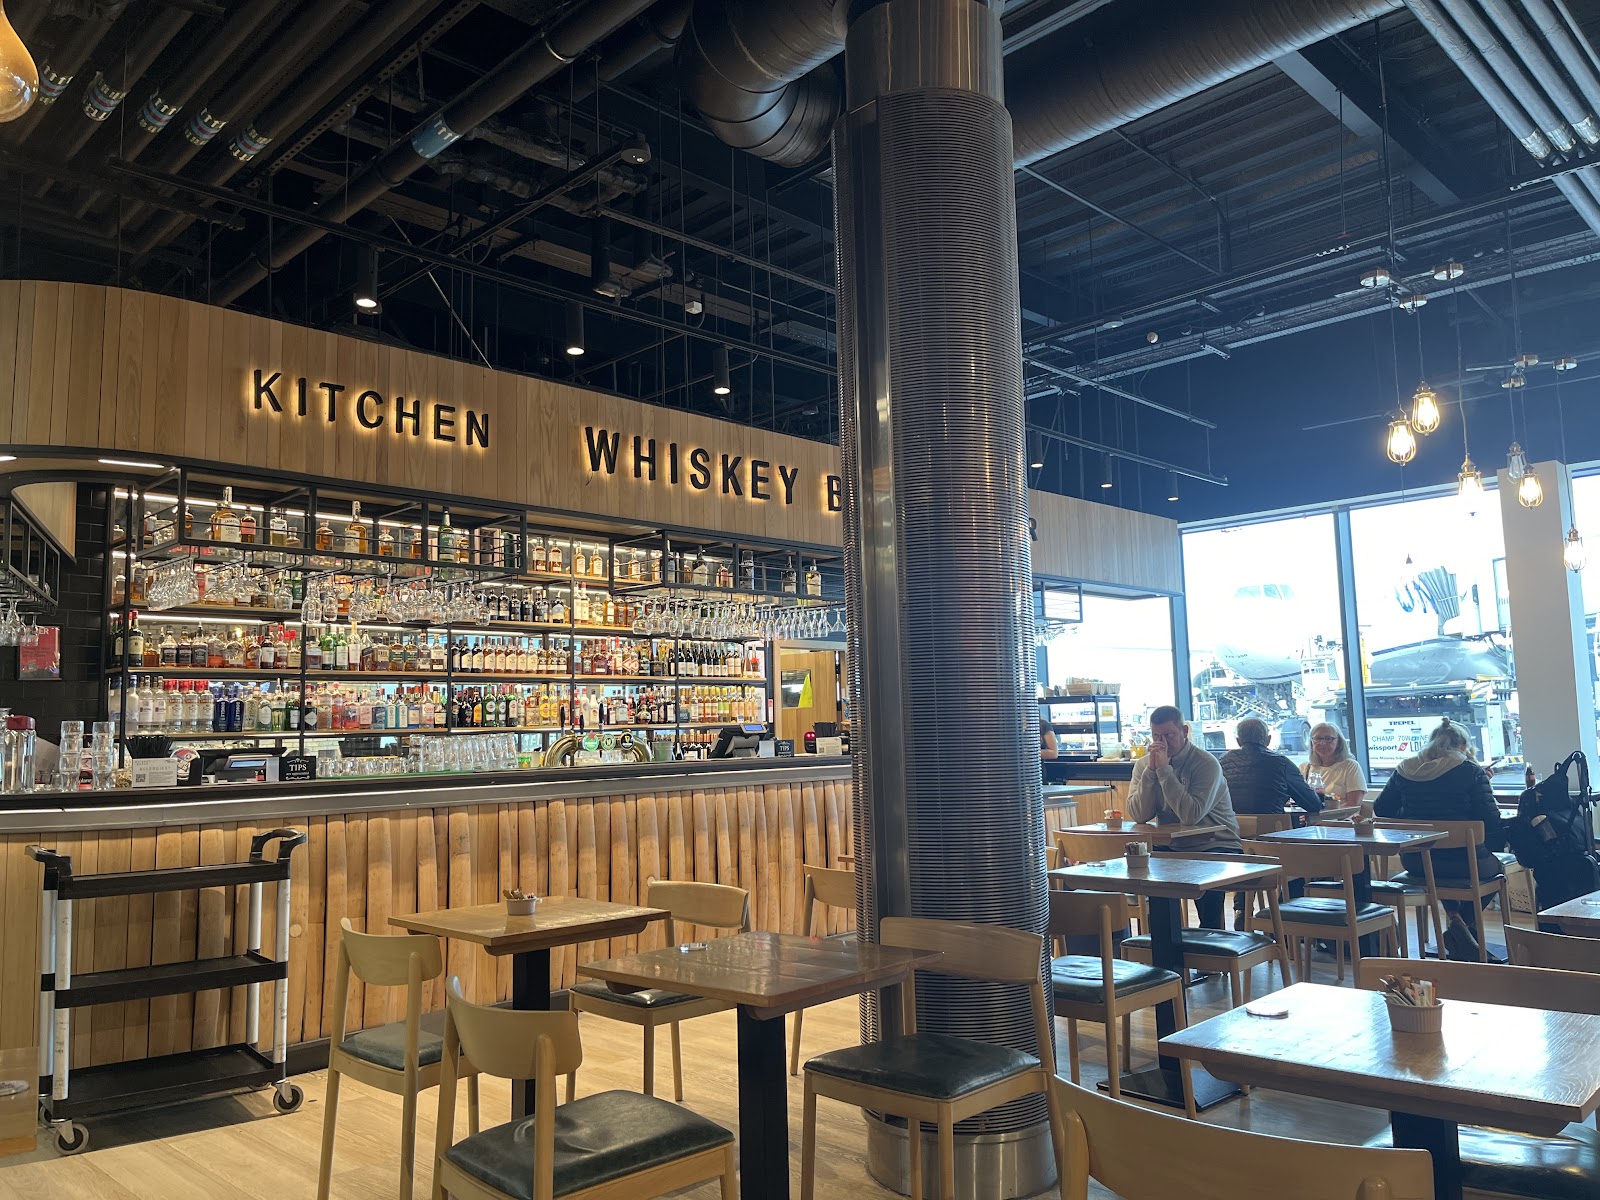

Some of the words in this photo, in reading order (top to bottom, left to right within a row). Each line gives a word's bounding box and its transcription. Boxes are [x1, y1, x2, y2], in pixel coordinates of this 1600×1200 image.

[253, 369, 489, 449] KITCHEN
[585, 427, 798, 505] WHISKEY
[289, 763, 307, 771] TIPS
